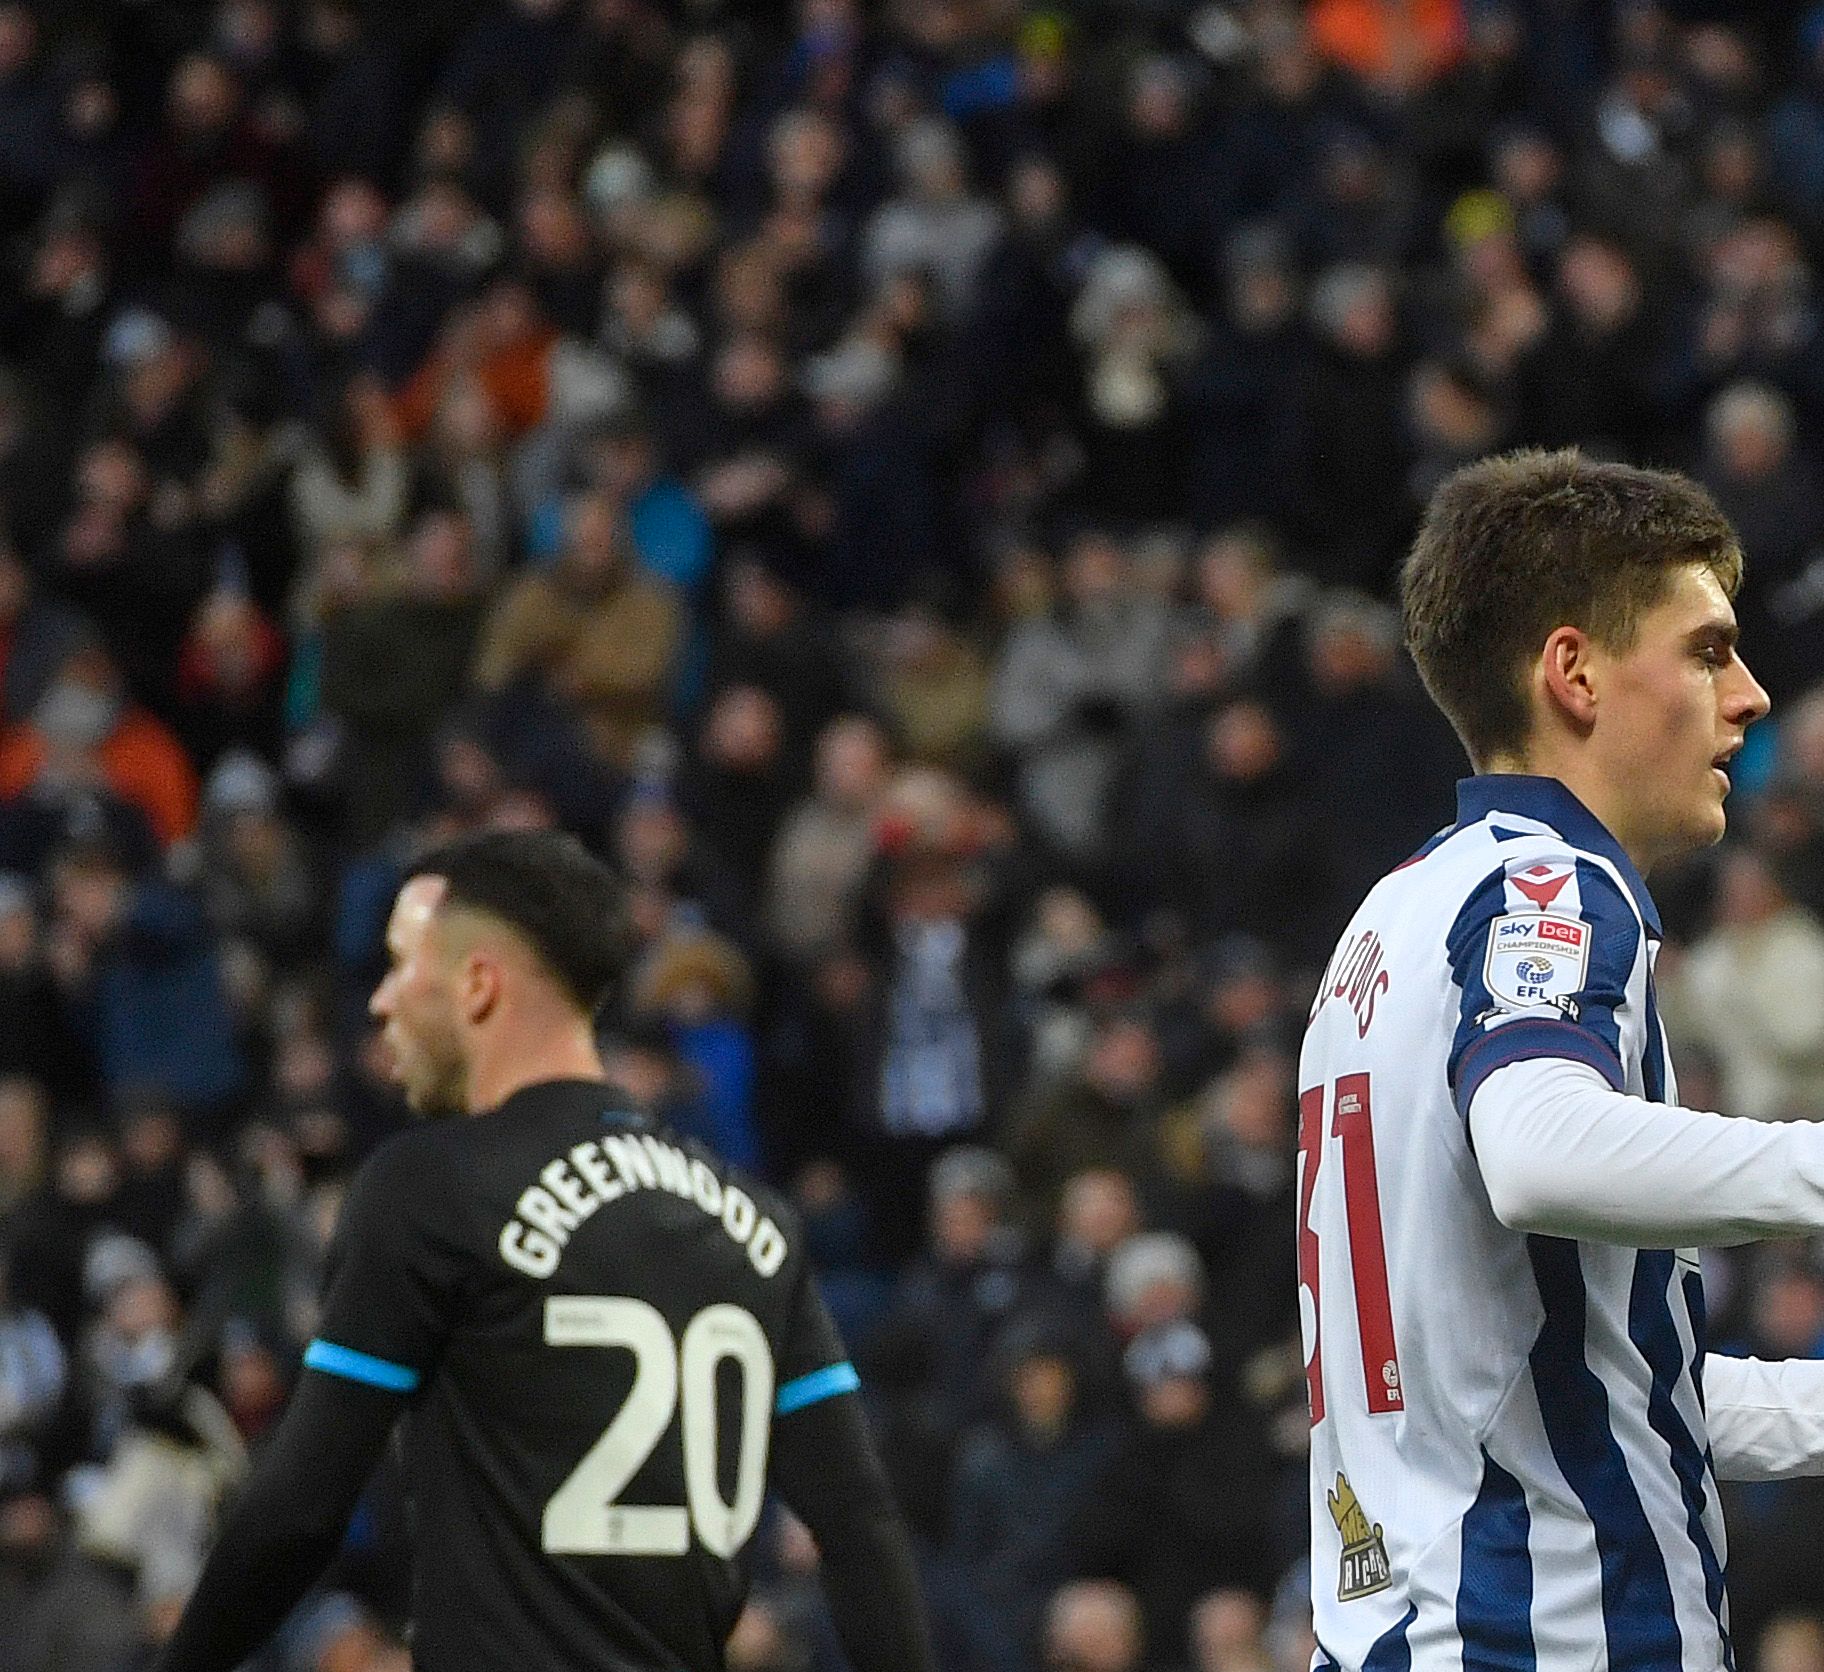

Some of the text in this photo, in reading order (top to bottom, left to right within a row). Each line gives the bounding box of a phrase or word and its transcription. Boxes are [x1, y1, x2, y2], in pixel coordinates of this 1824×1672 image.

[1499, 922, 1579, 942] sky bet
[1516, 985, 1548, 1000] EFL
[498, 1133, 788, 1279] GREENWOOD
[541, 1295, 774, 1561] 20
